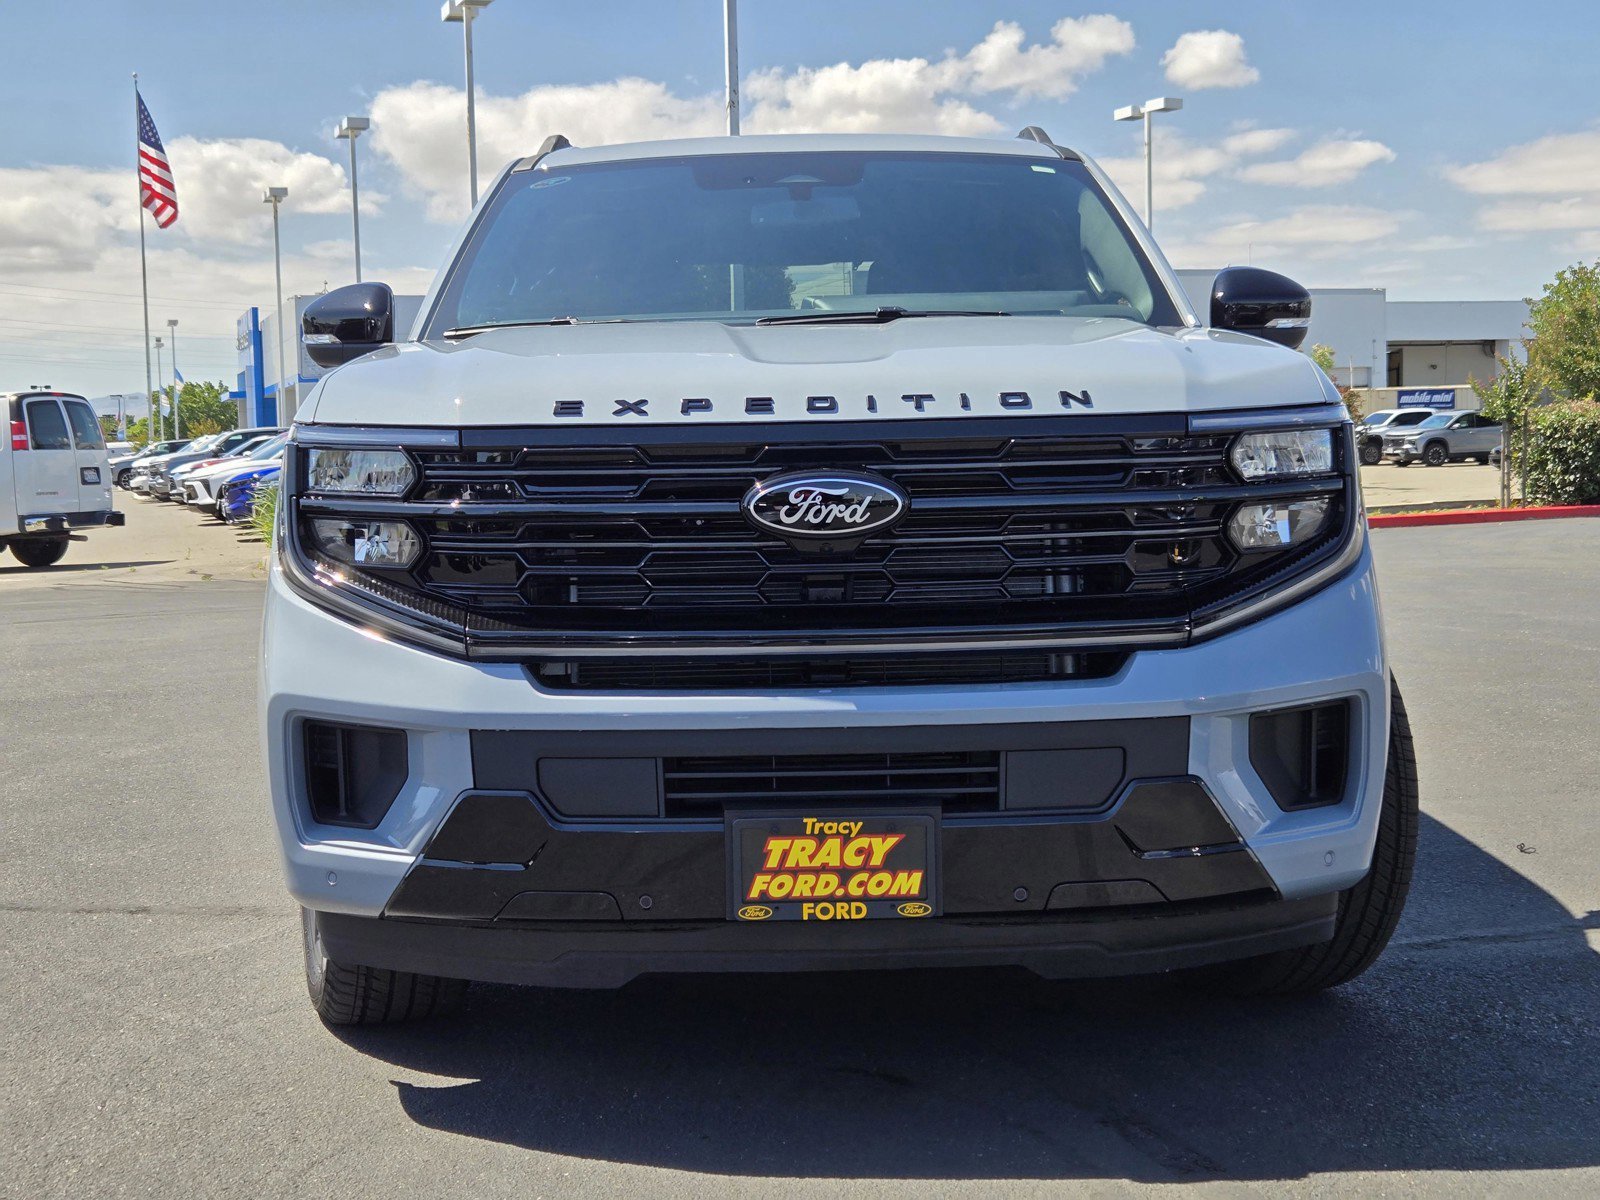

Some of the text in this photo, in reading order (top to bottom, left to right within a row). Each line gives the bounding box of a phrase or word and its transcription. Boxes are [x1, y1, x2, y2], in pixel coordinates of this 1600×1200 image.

[553, 389, 1092, 416] EXPEDITION
[1400, 391, 1454, 403] mobile mint
[780, 486, 871, 524] Ford
[803, 817, 863, 837] Tracy
[764, 835, 904, 870] TRACY
[748, 871, 923, 899] FORD.COM
[744, 907, 766, 917] Ford
[802, 902, 867, 920] FORD
[903, 904, 925, 914] Ford
